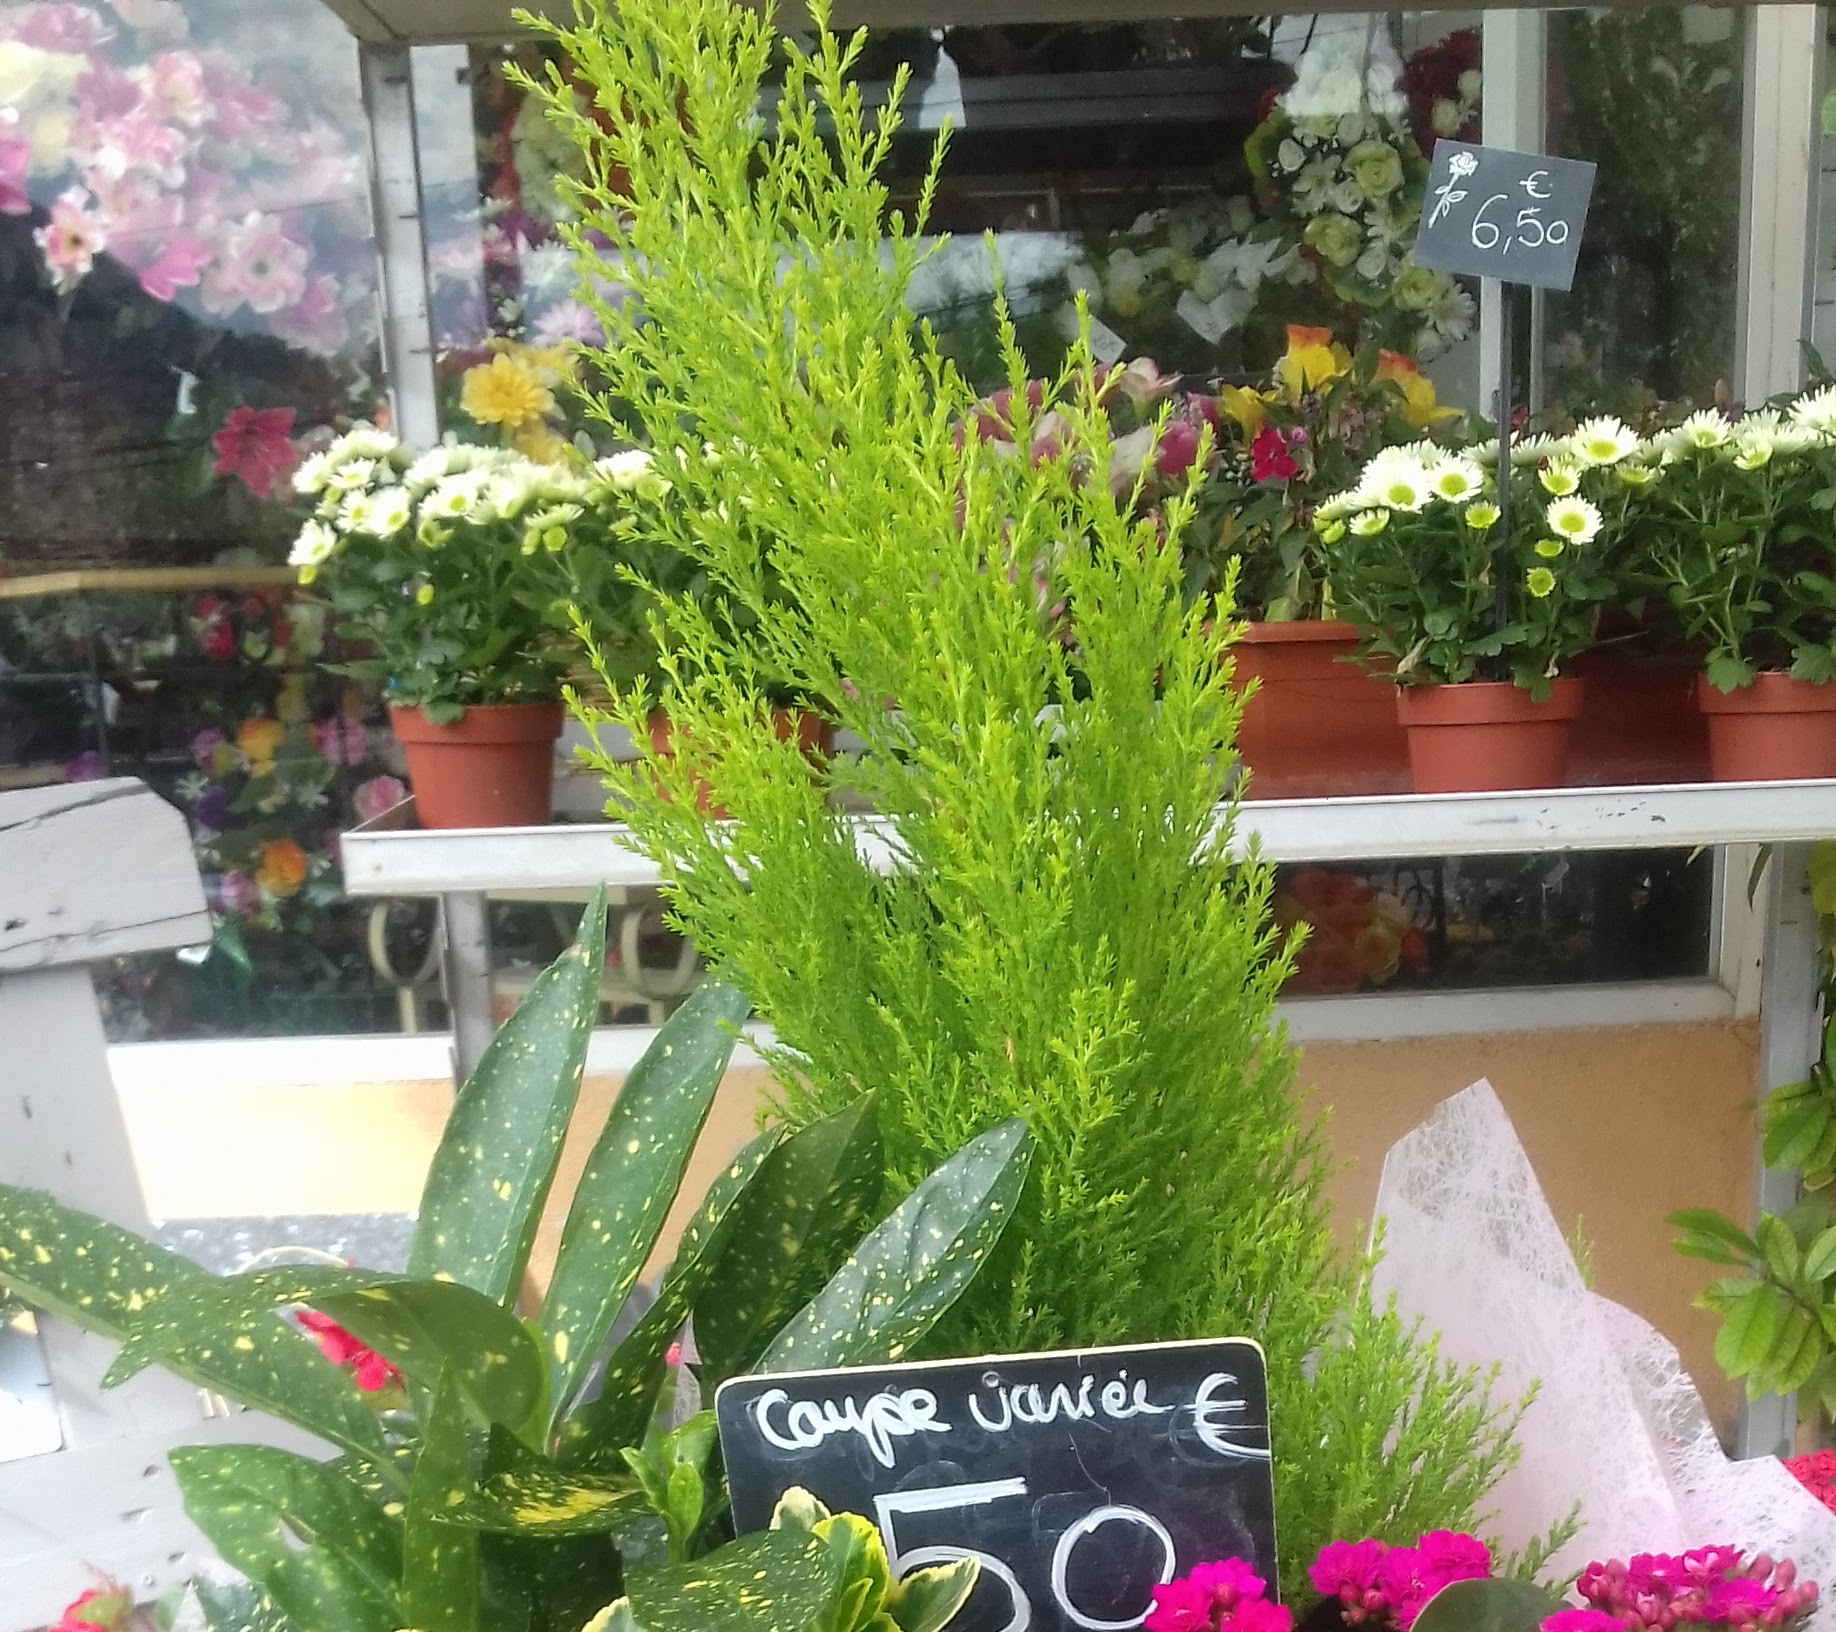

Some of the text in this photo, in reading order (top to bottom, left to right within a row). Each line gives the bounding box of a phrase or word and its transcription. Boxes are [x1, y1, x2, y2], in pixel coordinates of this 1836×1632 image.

[1519, 170, 1551, 198] €
[1471, 194, 1569, 255] 6,50
[1184, 1372, 1271, 1459] €
